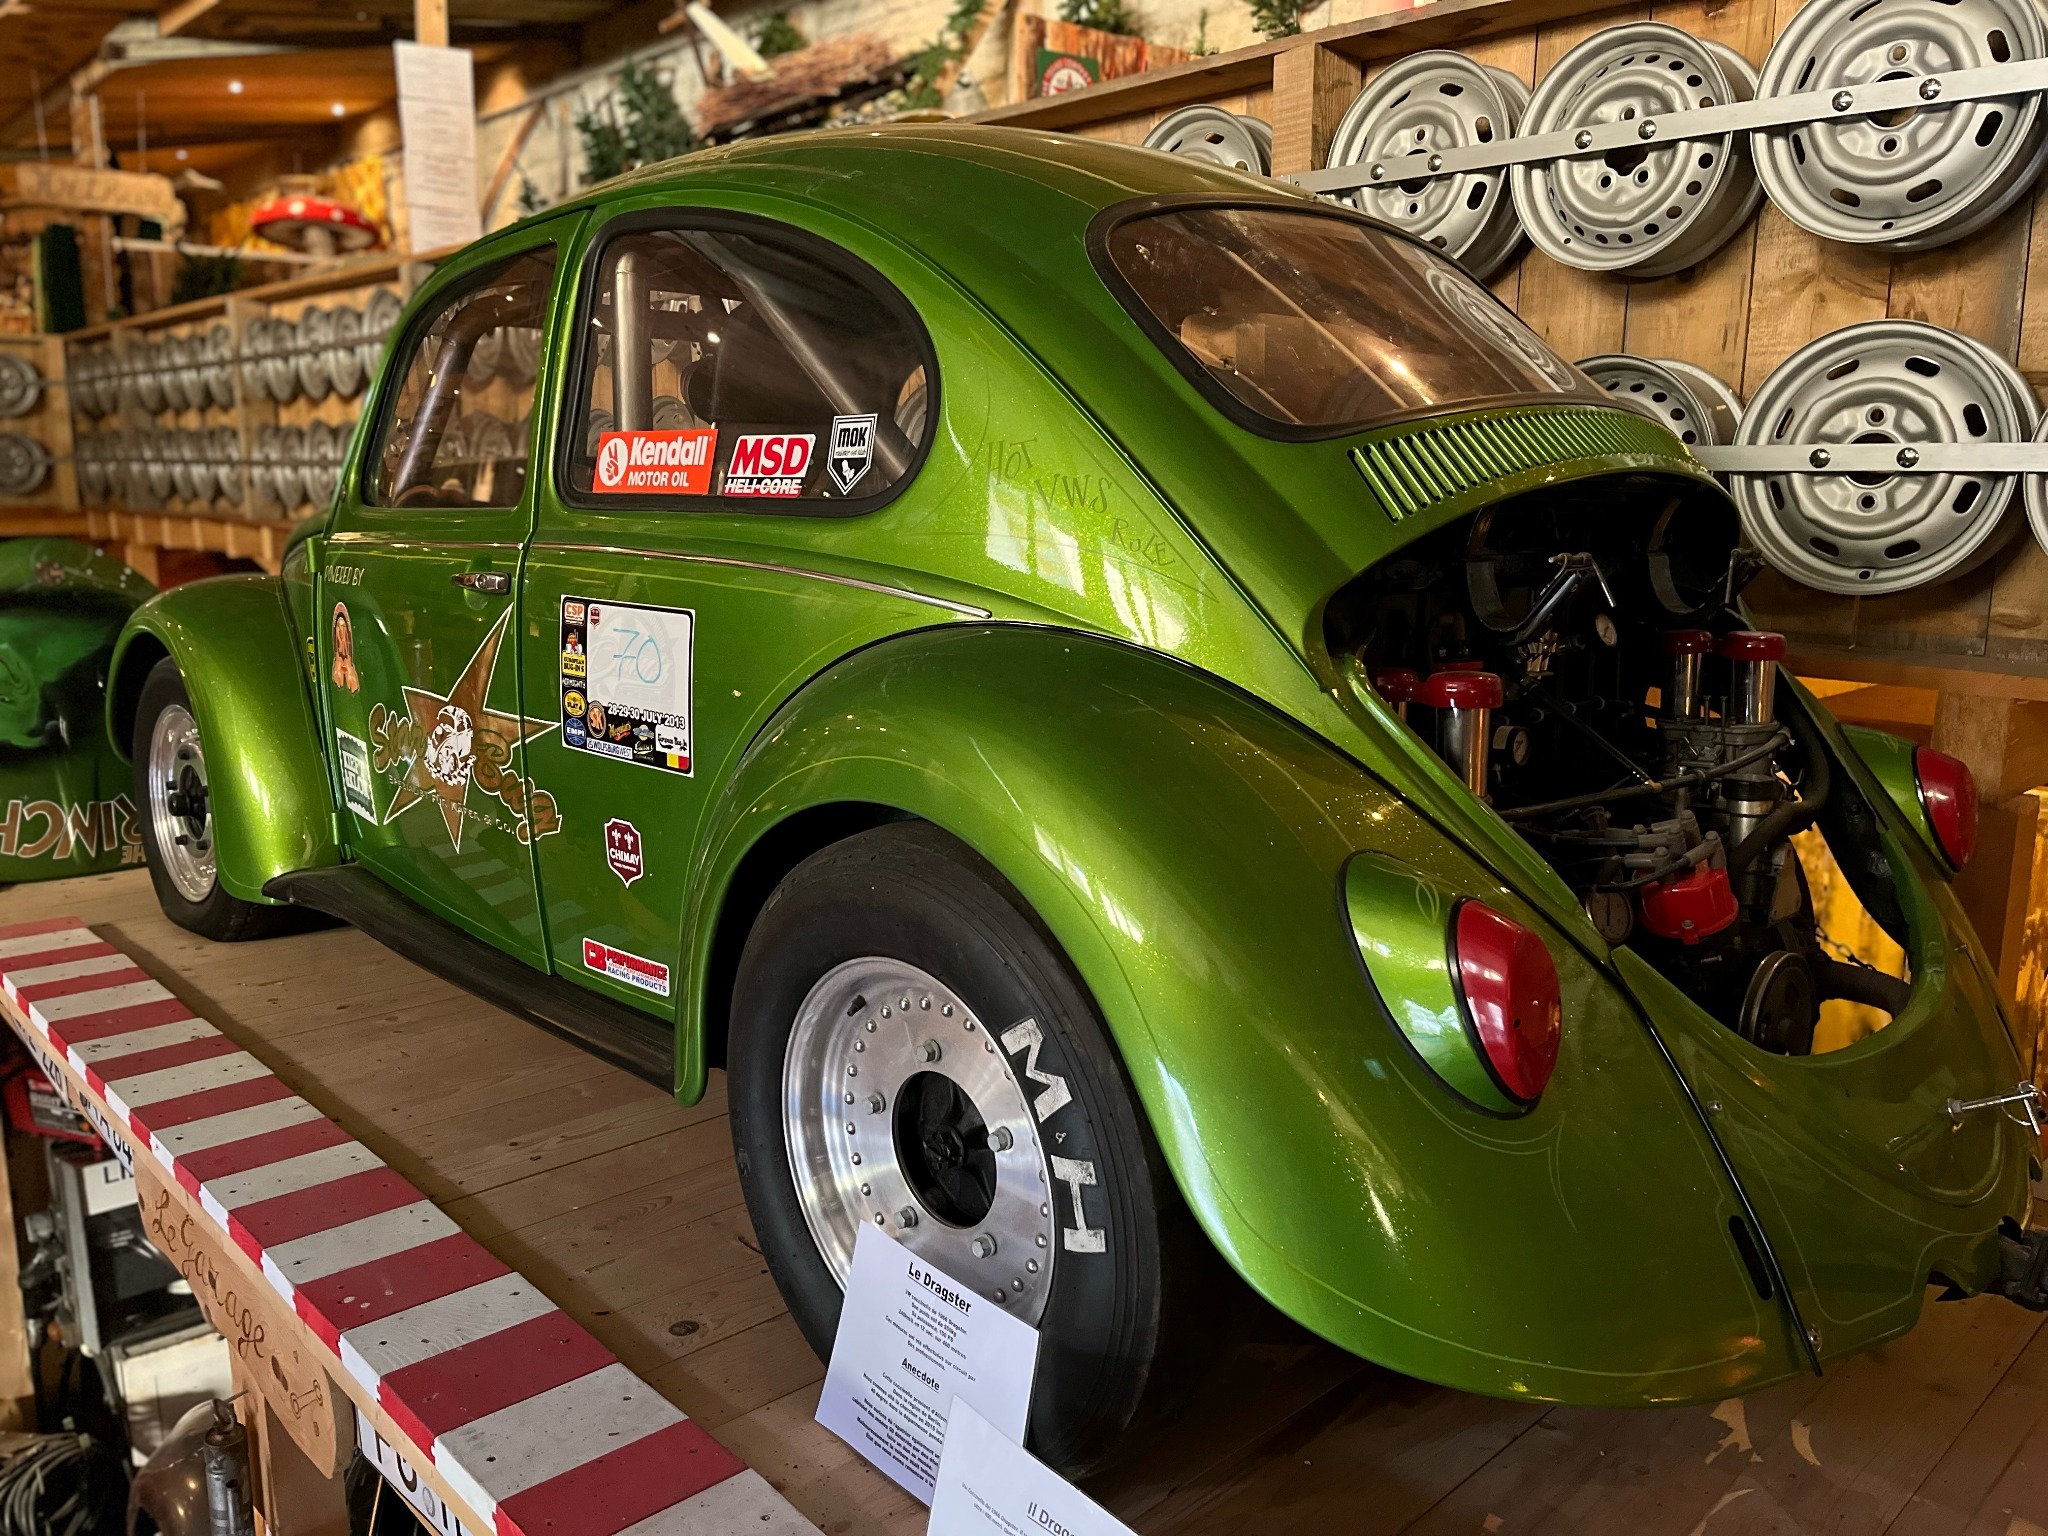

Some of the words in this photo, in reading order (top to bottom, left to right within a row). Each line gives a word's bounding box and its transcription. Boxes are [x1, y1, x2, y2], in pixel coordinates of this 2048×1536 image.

[628, 435, 708, 466] Kendall
[730, 437, 811, 476] MSD
[627, 471, 669, 487] MOTOR
[671, 474, 690, 487] OIL
[725, 478, 802, 494] HELI-CORE
[352, 568, 365, 586] BY
[566, 604, 584, 616] CSP
[613, 628, 661, 683] 70
[608, 703, 640, 720] 28-29-30
[641, 710, 662, 724] JULY
[664, 715, 685, 729] 2013
[567, 727, 584, 737] EMPI
[610, 848, 639, 866] CHIMAY
[607, 949, 667, 980] PERFORMANCE
[608, 966, 630, 979] RACING
[632, 974, 667, 993] PRODUCTS
[181, 1214, 265, 1358] Garage
[908, 1261, 920, 1281] Le
[923, 1272, 972, 1314] Dragster
[901, 1356, 940, 1391] Anecdote
[924, 1420, 935, 1431] 2015
[1027, 1501, 1037, 1517] Il
